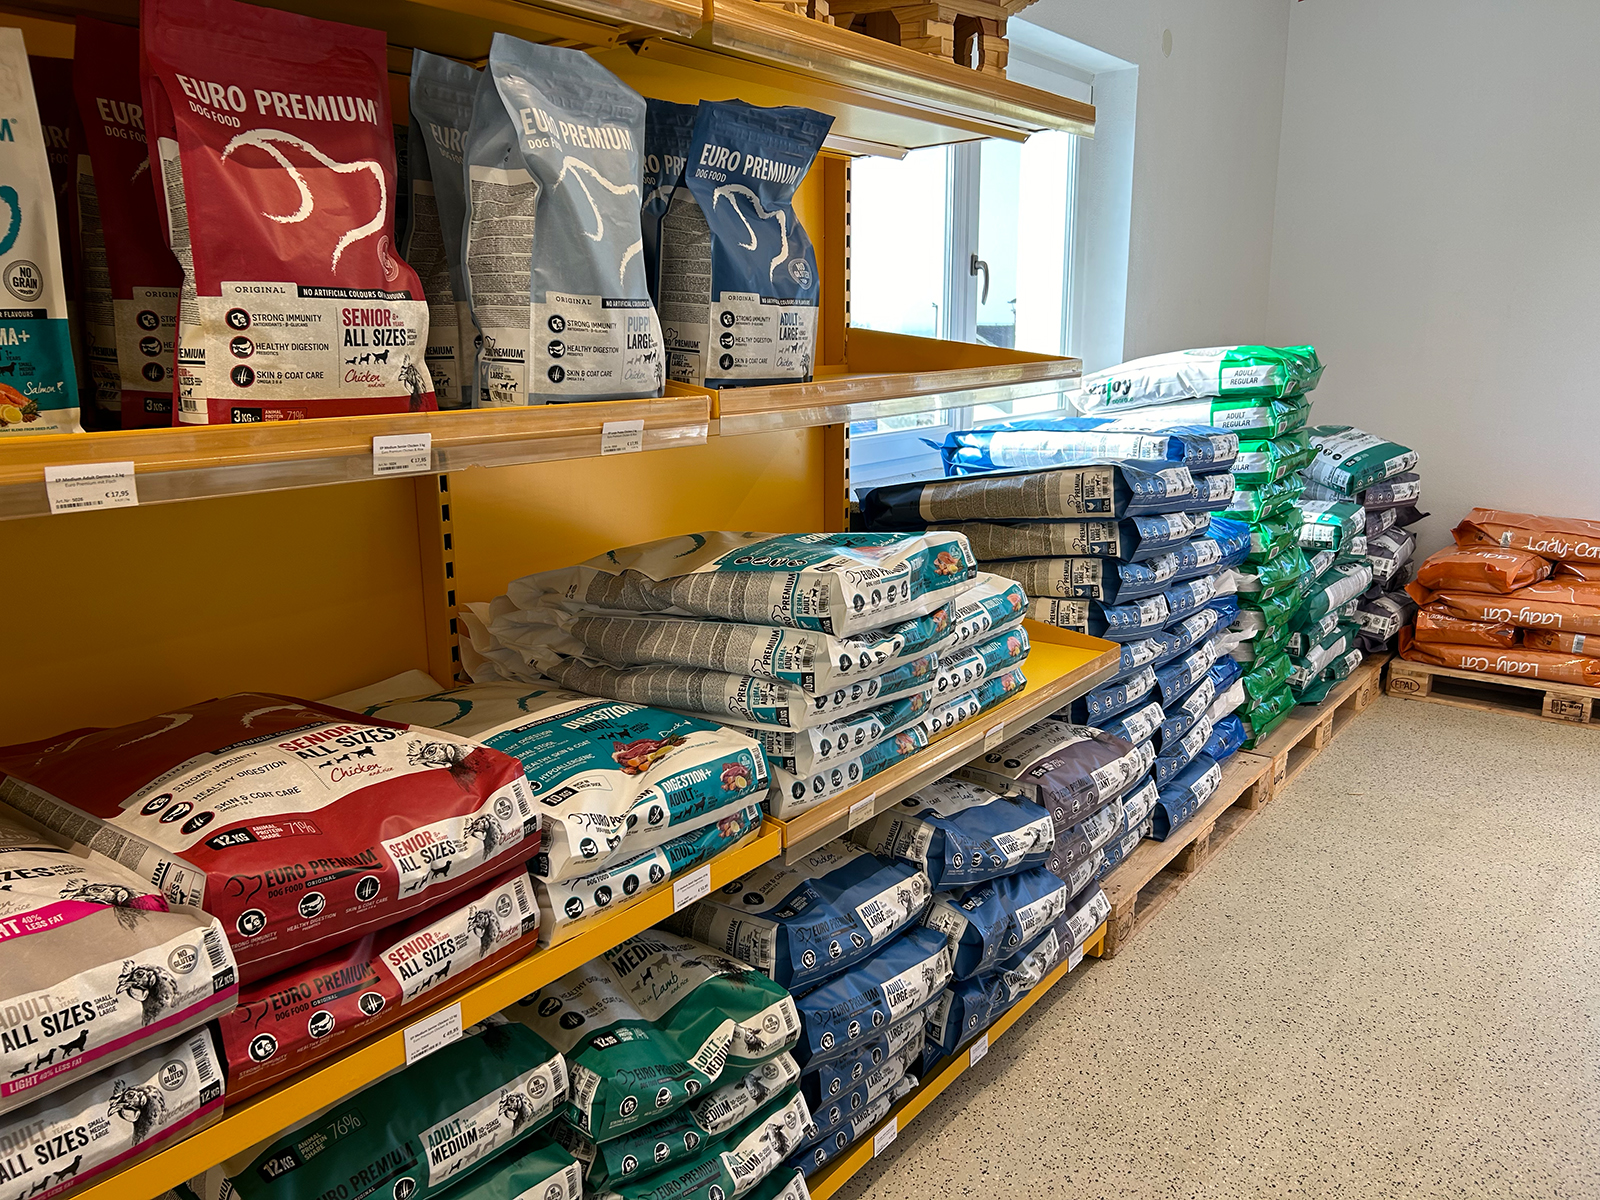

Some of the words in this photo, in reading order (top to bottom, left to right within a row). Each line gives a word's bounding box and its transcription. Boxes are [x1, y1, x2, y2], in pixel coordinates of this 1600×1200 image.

[175, 73, 247, 113] EURO
[254, 89, 378, 126] PREMIUM
[189, 100, 211, 119] DOG
[211, 110, 241, 128] FOOD
[528, 139, 550, 150] DOG
[559, 120, 634, 152] PREMIUM
[699, 143, 741, 172] EURO
[742, 154, 802, 185] PREMIUM
[695, 168, 708, 179] DOG
[708, 170, 727, 182] FOOD
[20, 267, 31, 279] NO
[12, 277, 37, 289] GRAIN
[235, 285, 286, 294] ORIGINAL
[314, 289, 347, 297] ARTIFICIAL
[348, 290, 377, 298] COLOURS
[555, 296, 593, 306] ORIGINAL
[252, 313, 284, 323] STRONG
[286, 314, 322, 323] IMMUNITY
[342, 308, 391, 327] SENIOR
[780, 312, 798, 326] ADULT
[343, 329, 367, 346] ALL
[372, 328, 406, 346] SIZES
[779, 327, 799, 340] LARGE
[256, 342, 290, 351] HEALTHY
[291, 343, 329, 351] DIGESTION
[492, 348, 526, 358] PREMIUM
[567, 346, 592, 354] HEALTHY
[674, 339, 701, 349] PREMIUM
[256, 371, 275, 379] SKIN
[277, 371, 283, 379] &
[284, 371, 303, 379] COAT
[305, 371, 324, 379] CARE
[344, 369, 380, 383] Chicken
[1229, 377, 1259, 385] REGULAR
[1234, 369, 1255, 378] ADULT
[24, 381, 56, 395] Salmon
[1222, 420, 1251, 428] REGULAR
[1225, 411, 1246, 420] ADULT
[111, 490, 129, 498] 17,95
[862, 567, 881, 581] EURO
[782, 573, 795, 611] PREMIUM
[1481, 607, 1563, 628] Lady-Cat
[763, 630, 780, 665] PREMIUM
[778, 646, 787, 670] DERMA+
[1458, 656, 1538, 677] Lady-Cat
[1395, 680, 1415, 691] EPAL
[580, 720, 611, 733] ADULT
[277, 725, 356, 752] SENIOR
[294, 745, 340, 760] ALL
[335, 726, 395, 748] SIZES
[330, 762, 381, 783] Chicken
[538, 753, 595, 782] HYPOALLERGENIC
[193, 775, 236, 801] HEALTHY
[236, 759, 287, 779] DIGESTION
[661, 769, 713, 794] DIGESTION+
[214, 796, 238, 811] SKIN
[249, 789, 274, 800] COAT
[275, 786, 302, 797] CARE
[544, 788, 575, 805] 10KG
[669, 788, 694, 808] ADULT
[588, 813, 608, 827] EURO
[212, 832, 251, 846] 12KG
[282, 822, 316, 834] 71%
[885, 820, 899, 855] PREMIUM
[999, 834, 1014, 847] ADULT
[389, 831, 435, 858] SENIOR
[398, 856, 421, 874] ALL
[420, 840, 456, 864] SIZES
[670, 847, 697, 864] ADULT
[809, 852, 834, 867] Chicken
[265, 864, 310, 888] EURO
[310, 849, 378, 874] PREMIUM
[267, 886, 284, 899] DOG
[284, 882, 304, 895] FOOD
[307, 874, 337, 887] ORIGINAL
[861, 900, 881, 919] ADULT
[1018, 908, 1033, 922] ADULT
[22, 914, 42, 924] 40%
[25, 920, 48, 931] LESS
[47, 914, 64, 926] FAT
[812, 919, 830, 936] EURO
[866, 911, 887, 929] LARGE
[177, 949, 188, 958] NO
[388, 932, 435, 967] SENIOR
[173, 954, 196, 968] GLUTEN
[398, 957, 423, 981] ALL
[422, 939, 456, 967] SIZES
[611, 940, 674, 978] MEDIUM
[213, 973, 235, 988] 12KG
[271, 981, 312, 1011] EURO
[314, 962, 378, 995] PREMIUM
[652, 971, 679, 1000] Lamb
[886, 978, 905, 997] ADULT
[94, 994, 113, 1004] SMALL
[97, 998, 119, 1011] MEDIUM
[832, 1005, 850, 1018] EURO
[850, 987, 880, 1010] PREMIUM
[889, 989, 909, 1007] LARGE
[99, 1006, 118, 1017] LARGE
[274, 1009, 291, 1022] DOG
[291, 1003, 310, 1016] FOOD
[312, 993, 339, 1007] ORIGINAL
[2, 1024, 38, 1053] ALL
[41, 1001, 96, 1038] SIZES
[694, 1036, 720, 1070] ADULT
[704, 1038, 733, 1077] MEDIUM
[9, 1074, 39, 1093] LIGHT
[54, 1062, 70, 1074] LESS
[70, 1057, 83, 1069] FAT
[164, 1070, 185, 1083] GLUTEN
[168, 1065, 177, 1074] NO
[200, 1087, 220, 1104] 12KG
[88, 1116, 106, 1128] SMALL
[89, 1120, 111, 1135] MEDIUM
[91, 1129, 110, 1141] LARGE
[297, 1133, 324, 1151] ANIMAL
[427, 1118, 461, 1150] ADULT
[262, 1155, 297, 1179] 12KG
[327, 1114, 362, 1140] 76%
[300, 1134, 328, 1156] PROTEIN
[304, 1145, 326, 1162] SHARE
[431, 1129, 478, 1167] MEDIUM
[0, 1154, 34, 1185] ALL
[34, 1126, 90, 1165] SIZES
[349, 1144, 415, 1194] PREMIUM
[657, 1180, 677, 1198] EURO
[679, 1158, 719, 1187] PREMIUM
